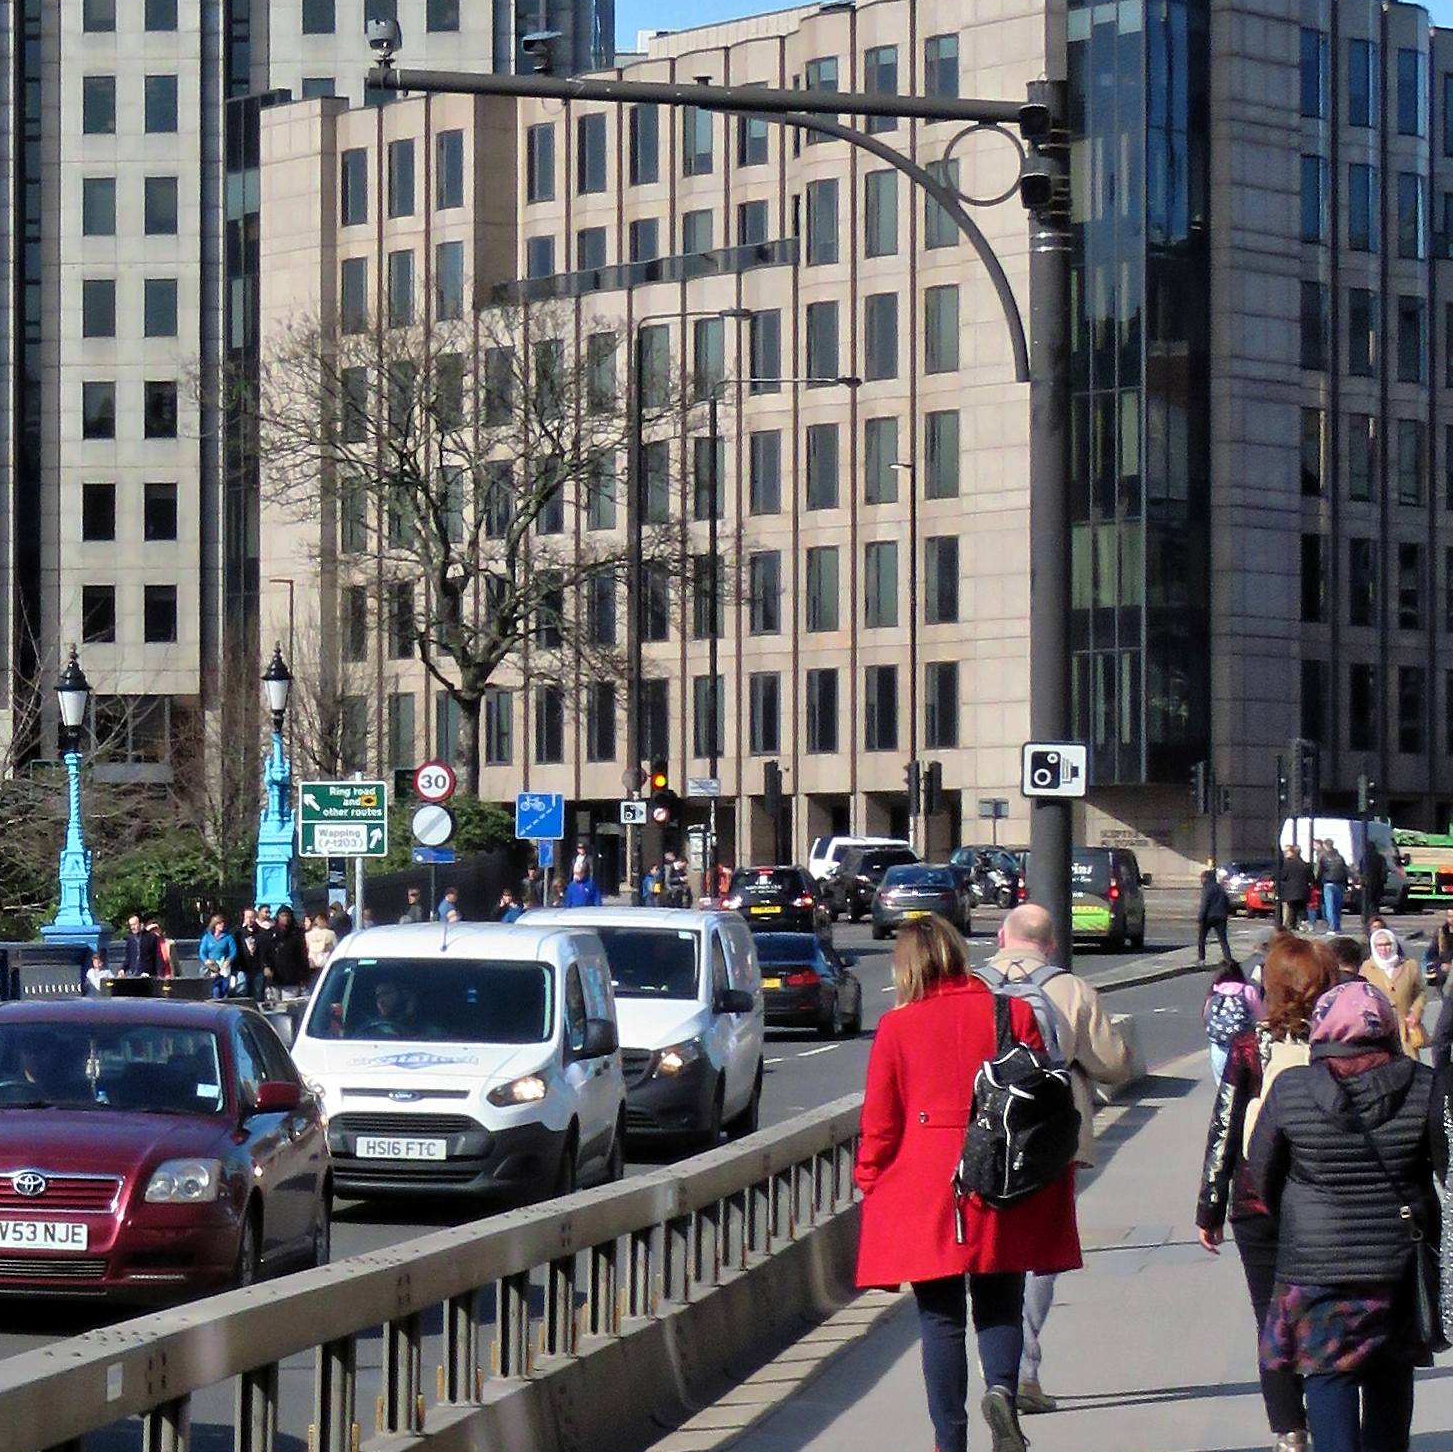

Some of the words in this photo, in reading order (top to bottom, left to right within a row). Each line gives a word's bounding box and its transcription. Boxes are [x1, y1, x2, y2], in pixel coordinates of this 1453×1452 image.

[420, 774, 447, 790] 30
[329, 786, 351, 798] Ring
[353, 786, 377, 796] road
[342, 797, 362, 807] and
[322, 807, 349, 817] other
[350, 808, 383, 817] routes
[317, 828, 361, 839] Wapping
[366, 1140, 402, 1156] HS16
[405, 1142, 437, 1157] FTC
[43, 1223, 84, 1245] NJE
